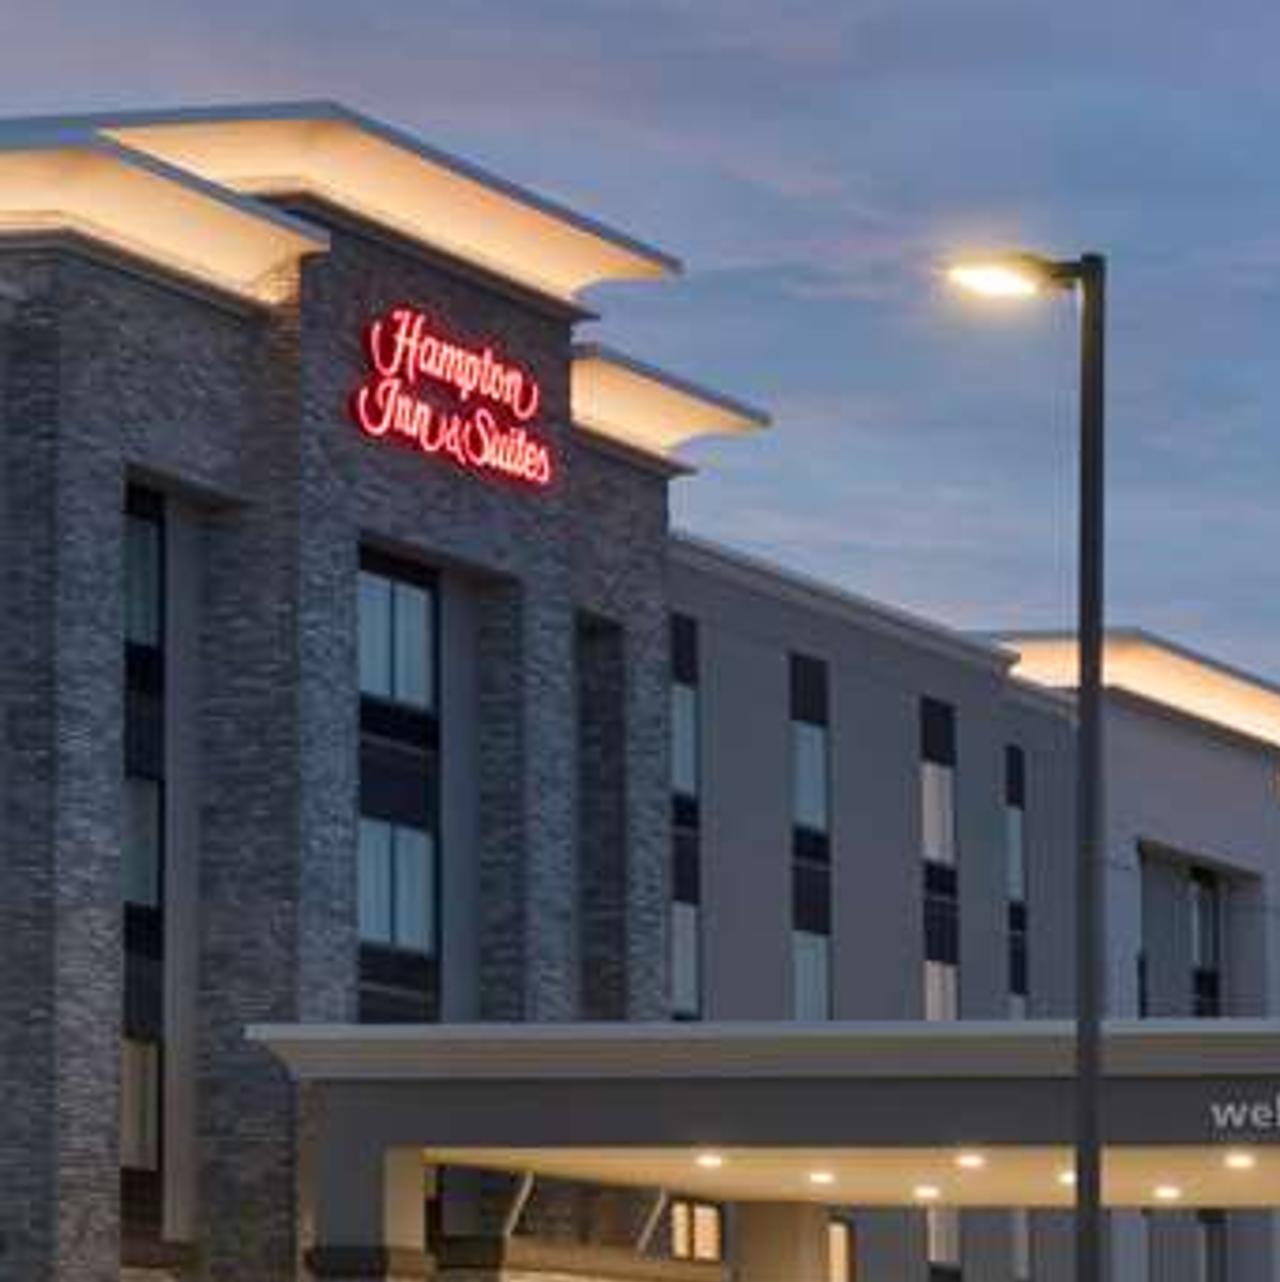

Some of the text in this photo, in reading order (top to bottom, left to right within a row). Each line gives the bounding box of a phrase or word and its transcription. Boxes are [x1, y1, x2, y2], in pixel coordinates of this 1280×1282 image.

[371, 310, 539, 420] Hampton
[359, 377, 447, 451] Inn
[464, 408, 550, 484] Suites
